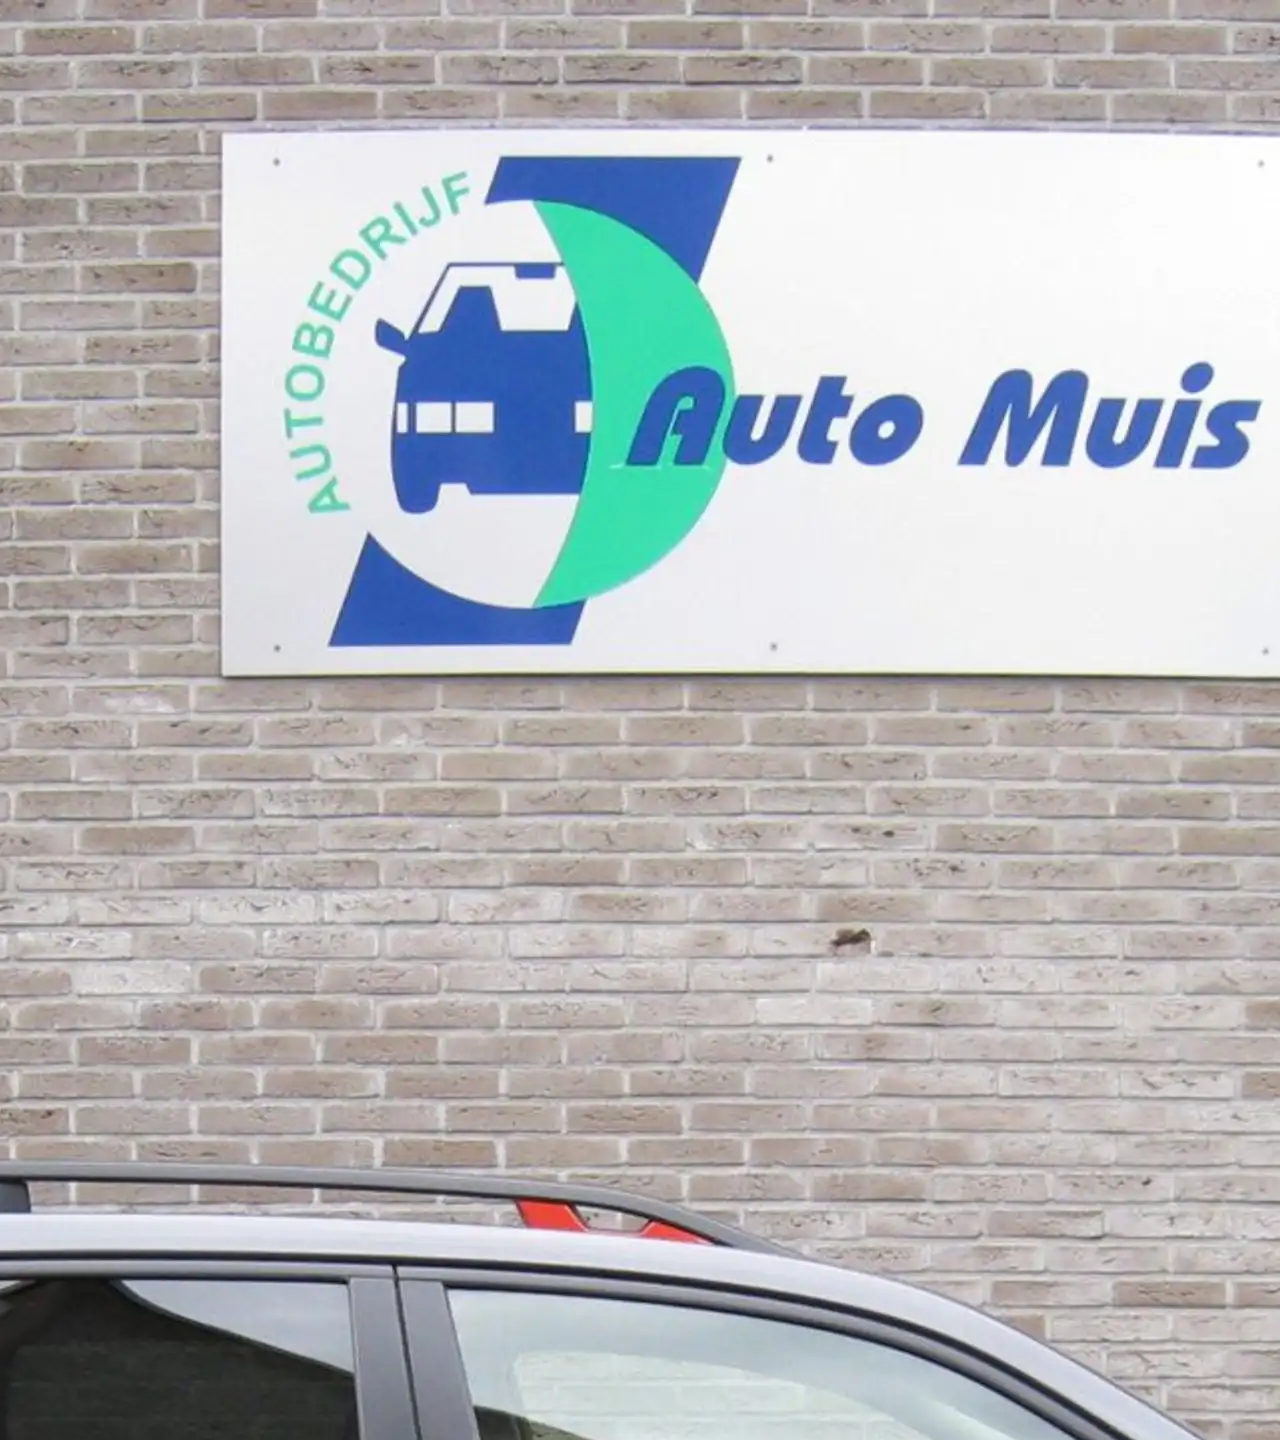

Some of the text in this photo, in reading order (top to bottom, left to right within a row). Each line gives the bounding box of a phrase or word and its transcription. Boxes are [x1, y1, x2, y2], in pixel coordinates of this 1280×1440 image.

[284, 170, 472, 516] AUTOBEDRIJF
[624, 361, 1262, 469] Auto Muis
